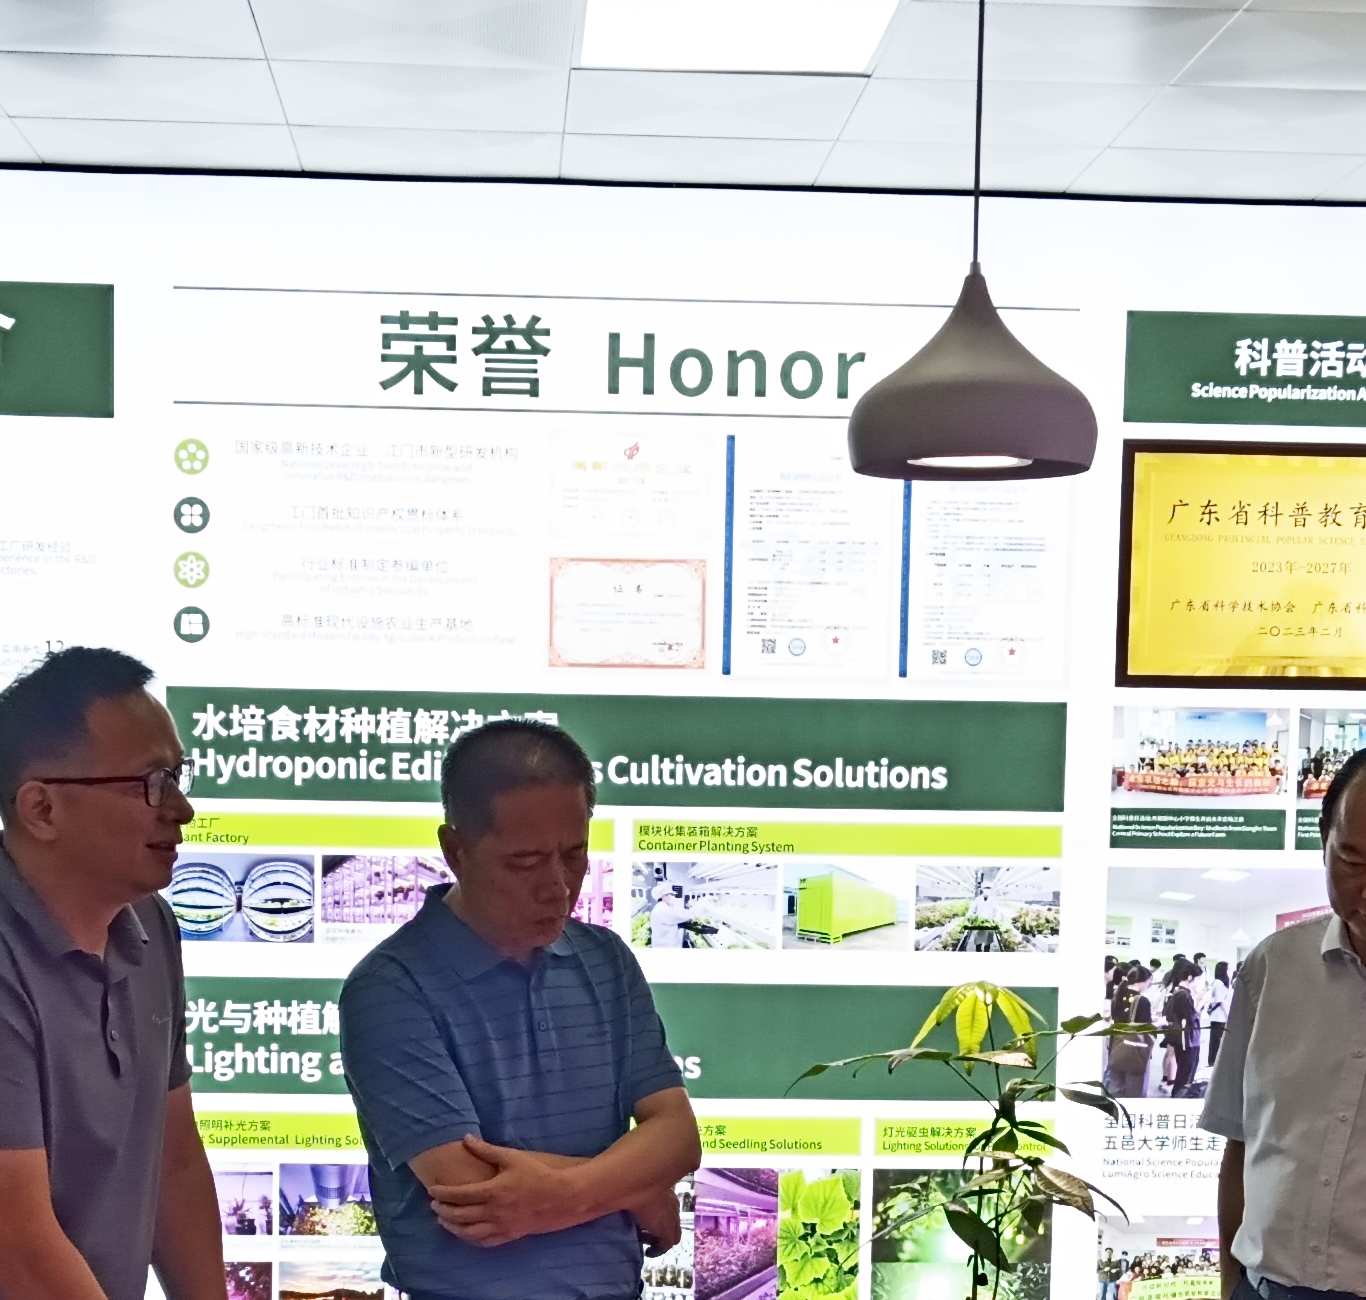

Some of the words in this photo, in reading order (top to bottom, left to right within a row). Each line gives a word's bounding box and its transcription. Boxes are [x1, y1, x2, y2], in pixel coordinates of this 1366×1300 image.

[379, 310, 551, 398] 荣誉
[607, 332, 866, 400] Honor
[1191, 382, 1248, 399] Science
[1249, 384, 1356, 403] Popularization
[42, 553, 53, 563] in
[54, 553, 72, 564] the
[73, 554, 97, 565] R&D
[1251, 560, 1353, 576] 2023年-2027年
[1169, 599, 1296, 614] 广东省科学技术协会
[192, 748, 386, 785] Hydroponic
[392, 750, 442, 781] Edi
[607, 755, 788, 788] Cultivation
[792, 758, 948, 790] Solutions
[184, 832, 203, 843] ant
[206, 831, 249, 846] Factory
[638, 825, 758, 839] 模块化集装箱解决方案
[638, 840, 698, 853] Container
[699, 841, 750, 856] Planting
[751, 842, 795, 856] System
[188, 1043, 322, 1082] Lighting
[195, 1120, 271, 1132] 照明补光方案
[882, 1126, 976, 1138] 灯光驱虫解决方案
[208, 1133, 290, 1147] Supplemental
[295, 1135, 343, 1148] Lighting
[718, 1138, 767, 1152] Seedling
[769, 1138, 822, 1150] Solutions
[882, 1140, 922, 1153] Lighting
[1103, 1135, 1221, 1151] 五邑大学师生走
[1103, 1158, 1145, 1166] National
[1146, 1158, 1183, 1167] Science
[1185, 1158, 1219, 1168] Popula
[1102, 1170, 1150, 1180] LumiAgro
[1152, 1171, 1188, 1179] Science
